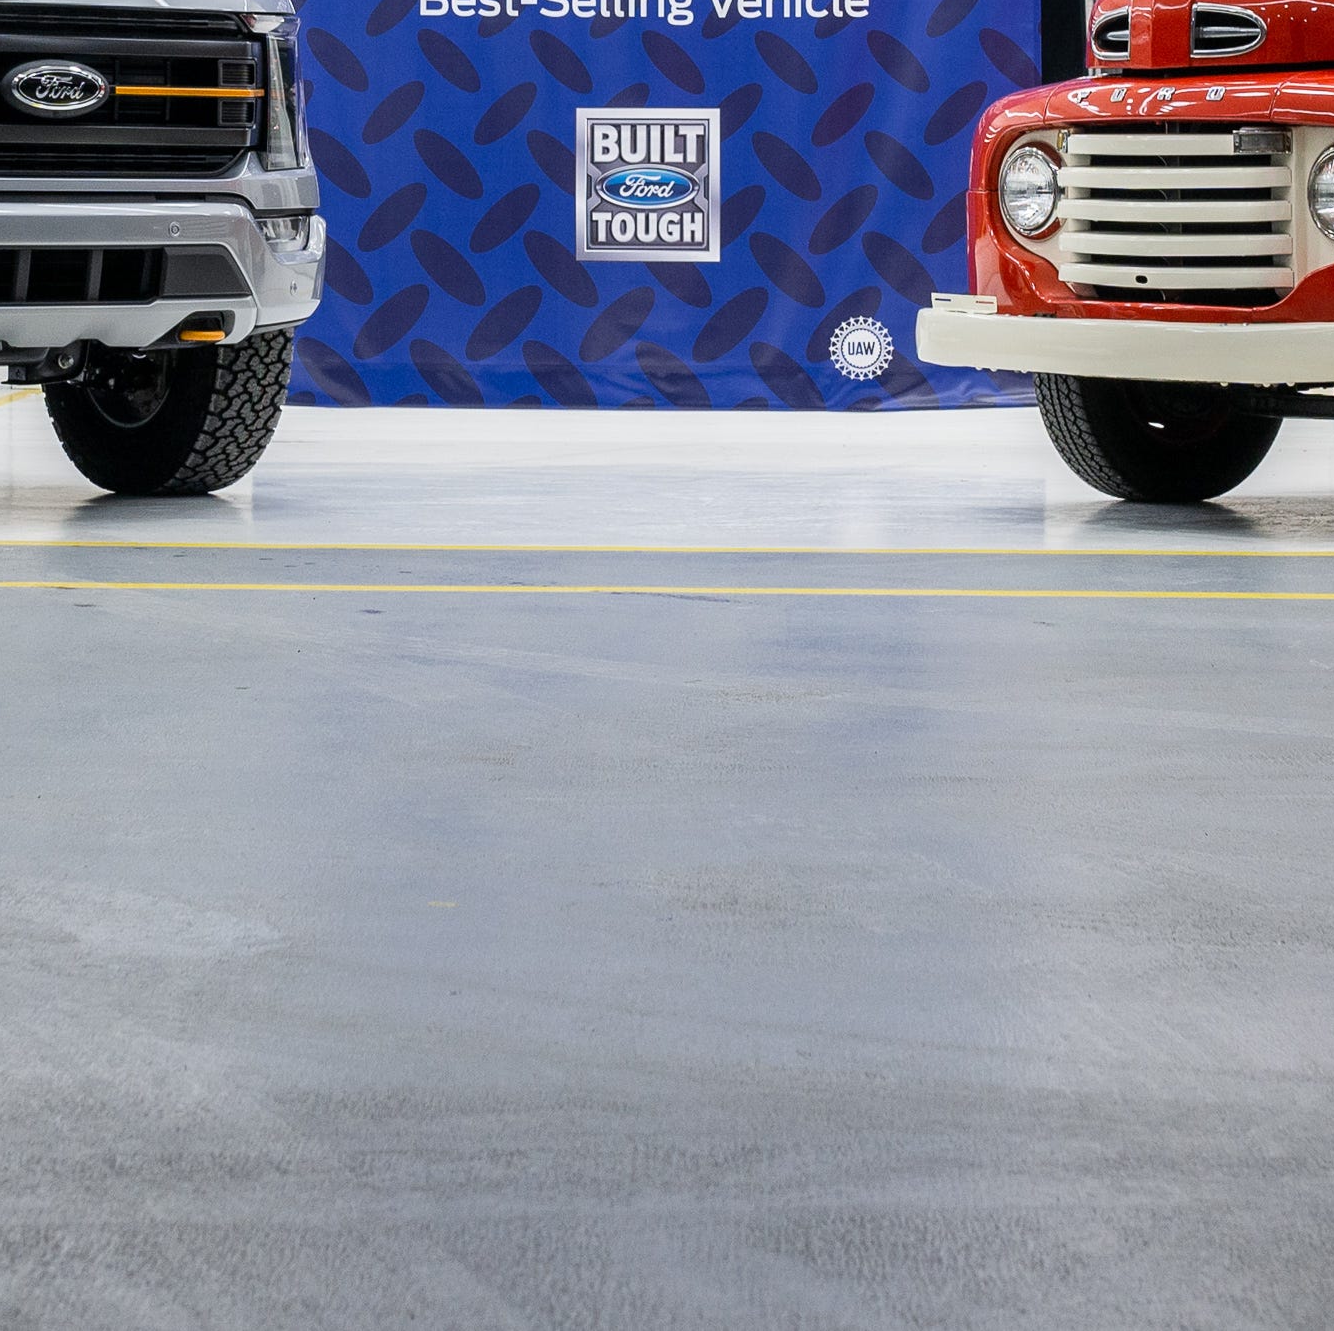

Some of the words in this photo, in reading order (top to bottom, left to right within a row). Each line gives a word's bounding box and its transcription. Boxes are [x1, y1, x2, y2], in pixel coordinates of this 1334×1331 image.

[30, 74, 86, 100] Ford
[593, 124, 705, 163] BUILT
[619, 173, 675, 198] Ford
[591, 211, 704, 243] TOUGH
[848, 341, 875, 355] UAW
